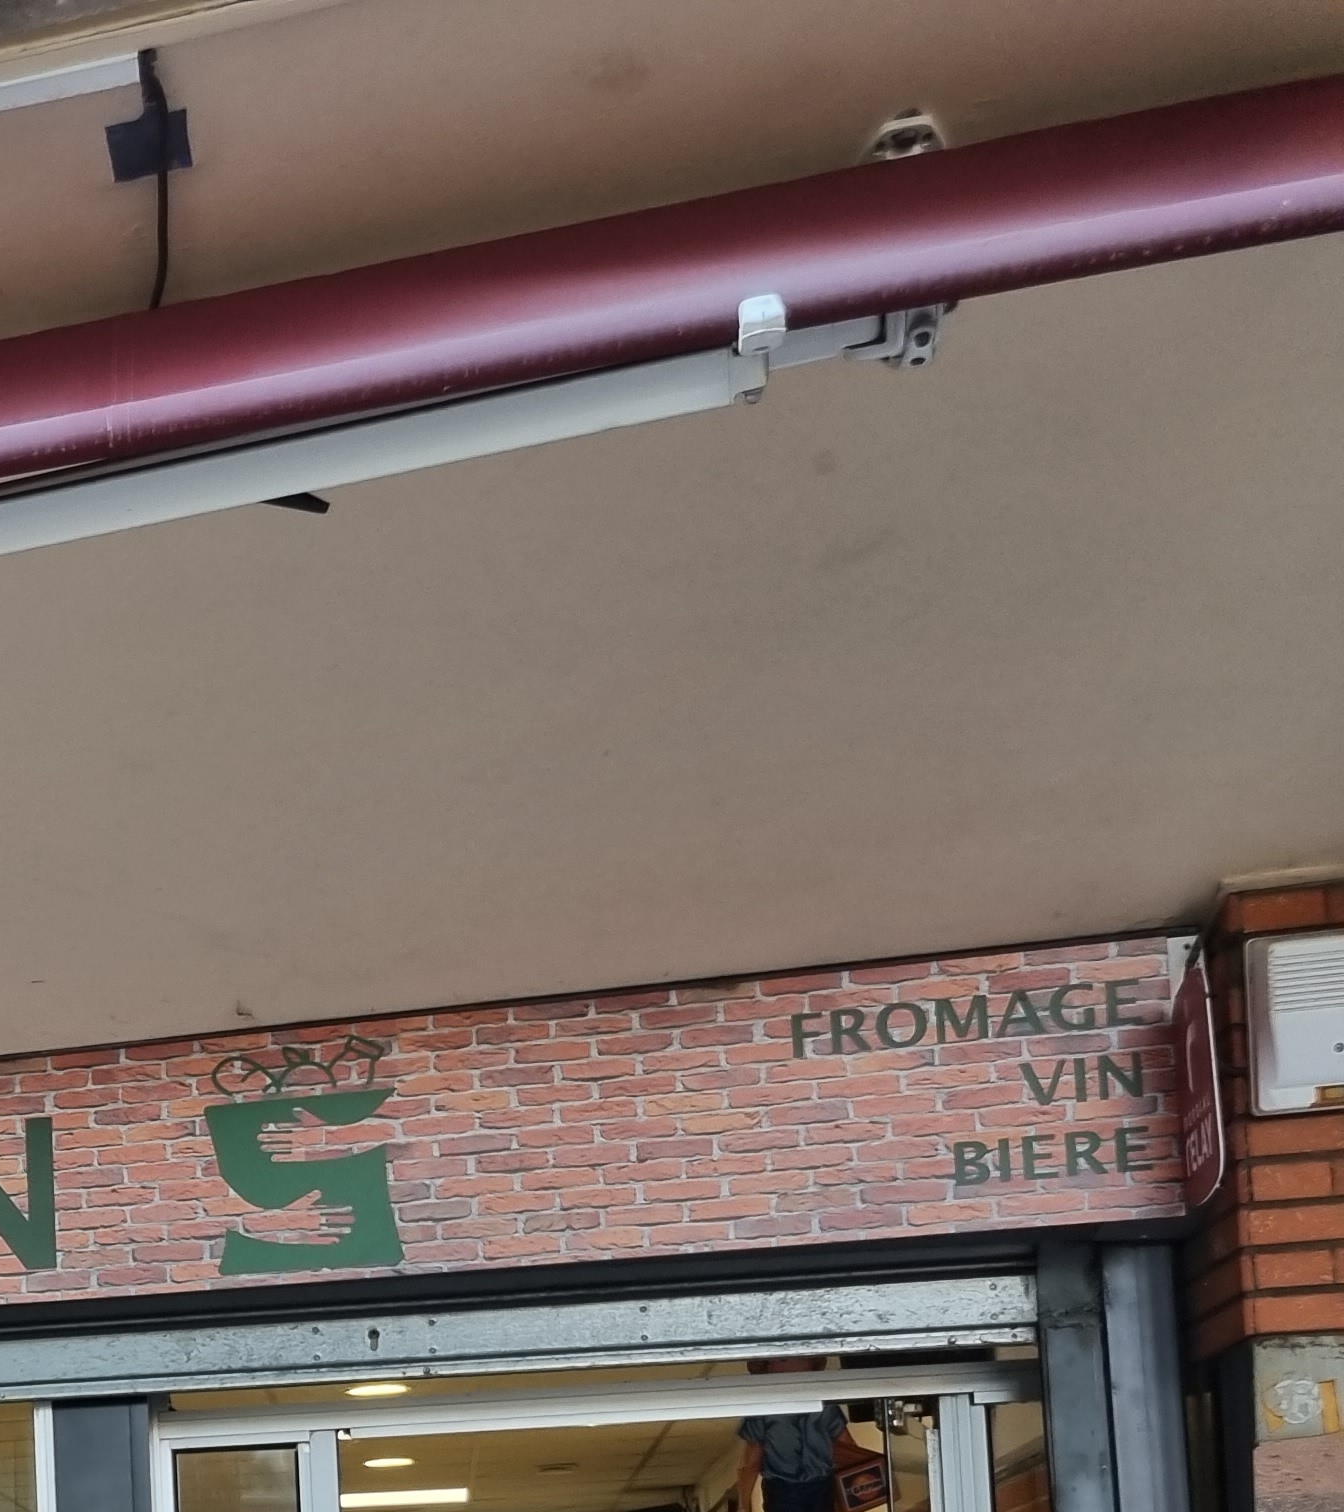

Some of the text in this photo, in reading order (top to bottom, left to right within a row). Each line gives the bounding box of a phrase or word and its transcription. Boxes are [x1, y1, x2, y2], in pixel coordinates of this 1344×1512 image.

[791, 980, 1142, 1059] FROMAGE
[1019, 1051, 1144, 1105] VIN
[953, 1125, 1154, 1187] BIERE
